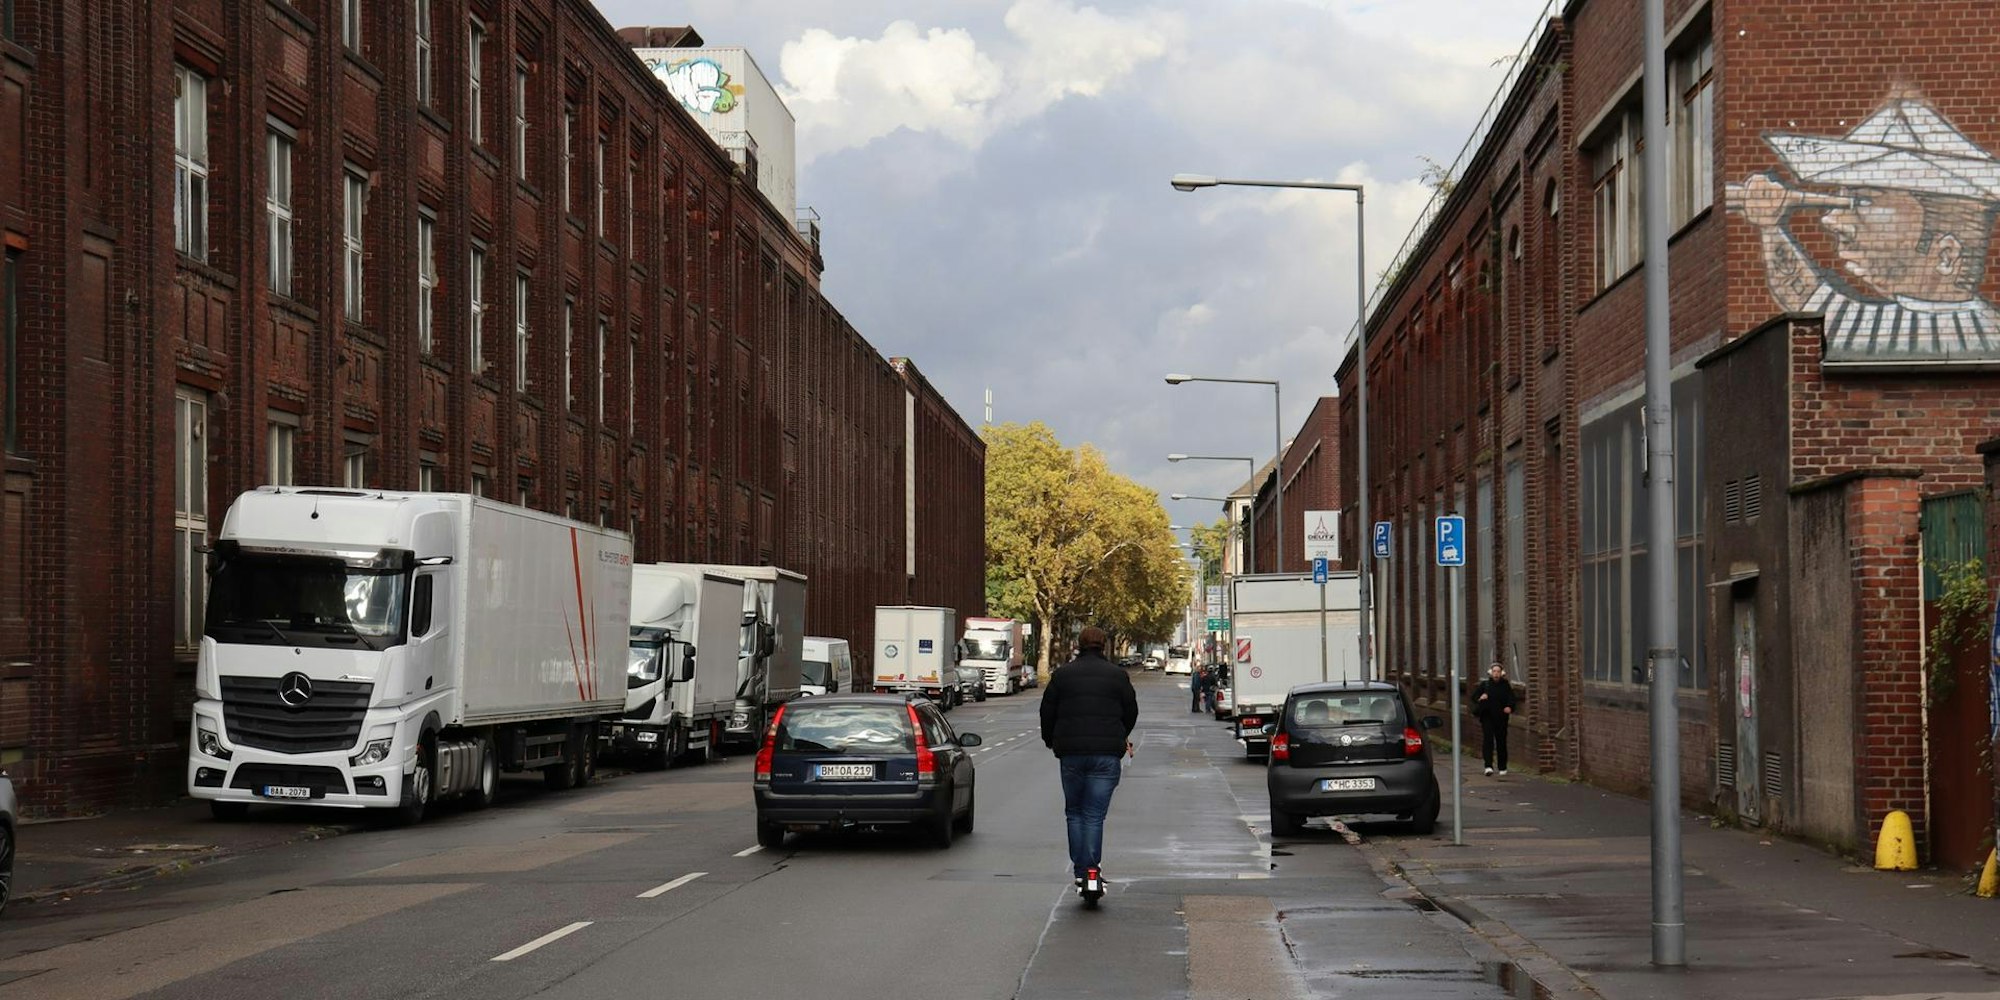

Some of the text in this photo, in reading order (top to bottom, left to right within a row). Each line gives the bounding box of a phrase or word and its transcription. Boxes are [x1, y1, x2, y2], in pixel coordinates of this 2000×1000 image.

[1376, 525, 1385, 541] P
[1440, 521, 1453, 542] P
[1307, 534, 1335, 542] DEUTZ
[1315, 559, 1322, 572] P
[821, 766, 872, 776] BM OA 219
[1327, 780, 1333, 789] K
[1353, 779, 1375, 788] 3353
[289, 788, 307, 797] 2078
